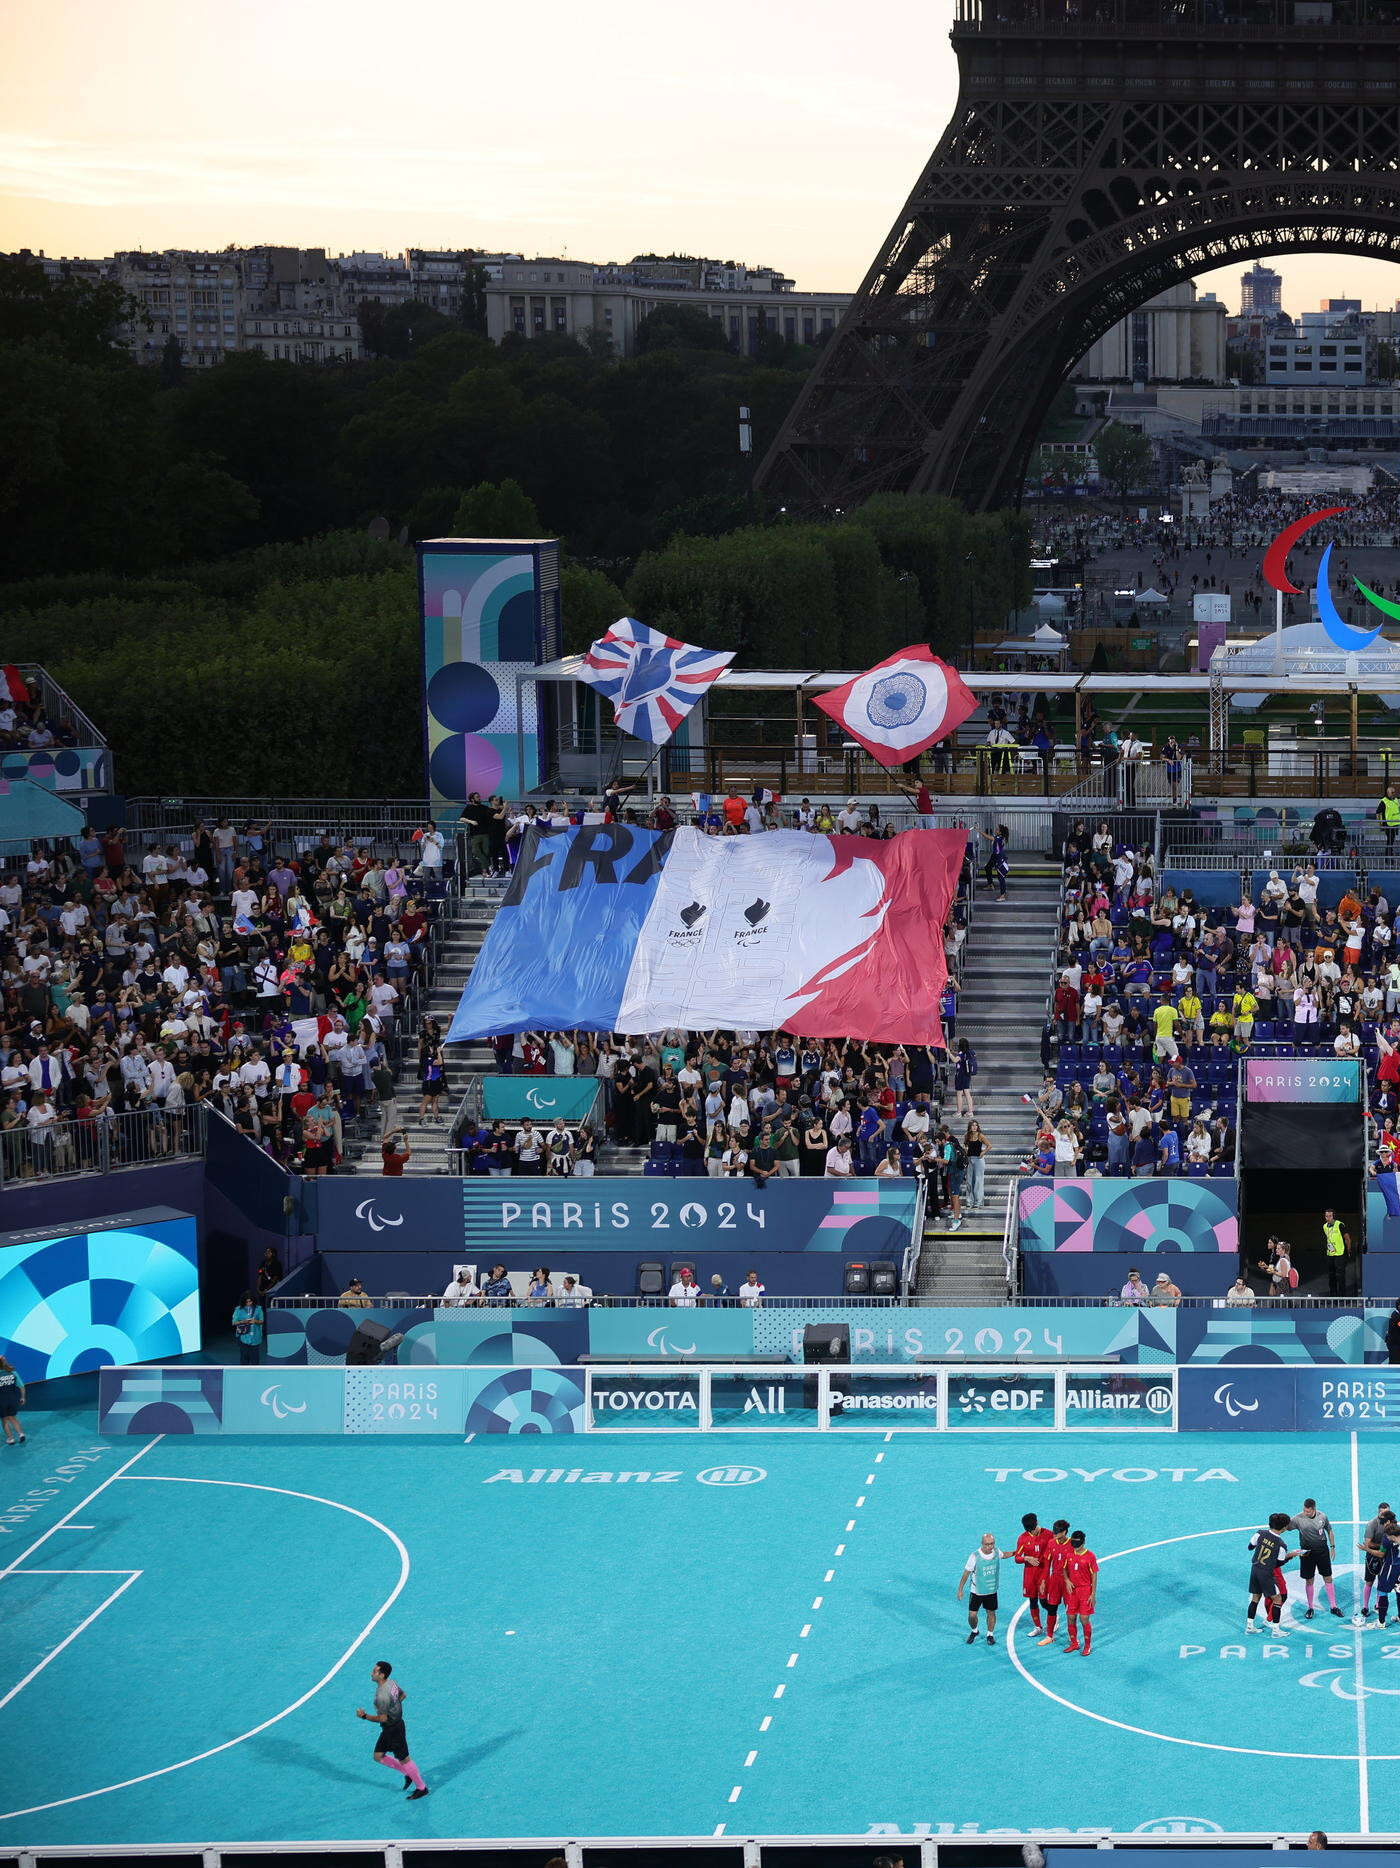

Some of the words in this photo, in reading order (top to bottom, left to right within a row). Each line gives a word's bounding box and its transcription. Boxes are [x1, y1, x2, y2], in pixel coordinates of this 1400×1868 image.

[668, 928, 704, 939] FRANCE
[734, 925, 769, 939] FRANCE
[1308, 1076, 1351, 1087] 2024
[650, 1202, 765, 1228] 2024
[944, 1327, 1063, 1355] 2024
[593, 1391, 697, 1410] TOYOTA
[829, 1390, 937, 1408] Panasonic
[1065, 1390, 1141, 1409] Allianz
[372, 1403, 438, 1420] 2024
[1322, 1401, 1386, 1418] 2024
[482, 1468, 684, 1484] Allianz
[984, 1467, 1240, 1483] TOYOTA
[1257, 1544, 1273, 1566] 12
